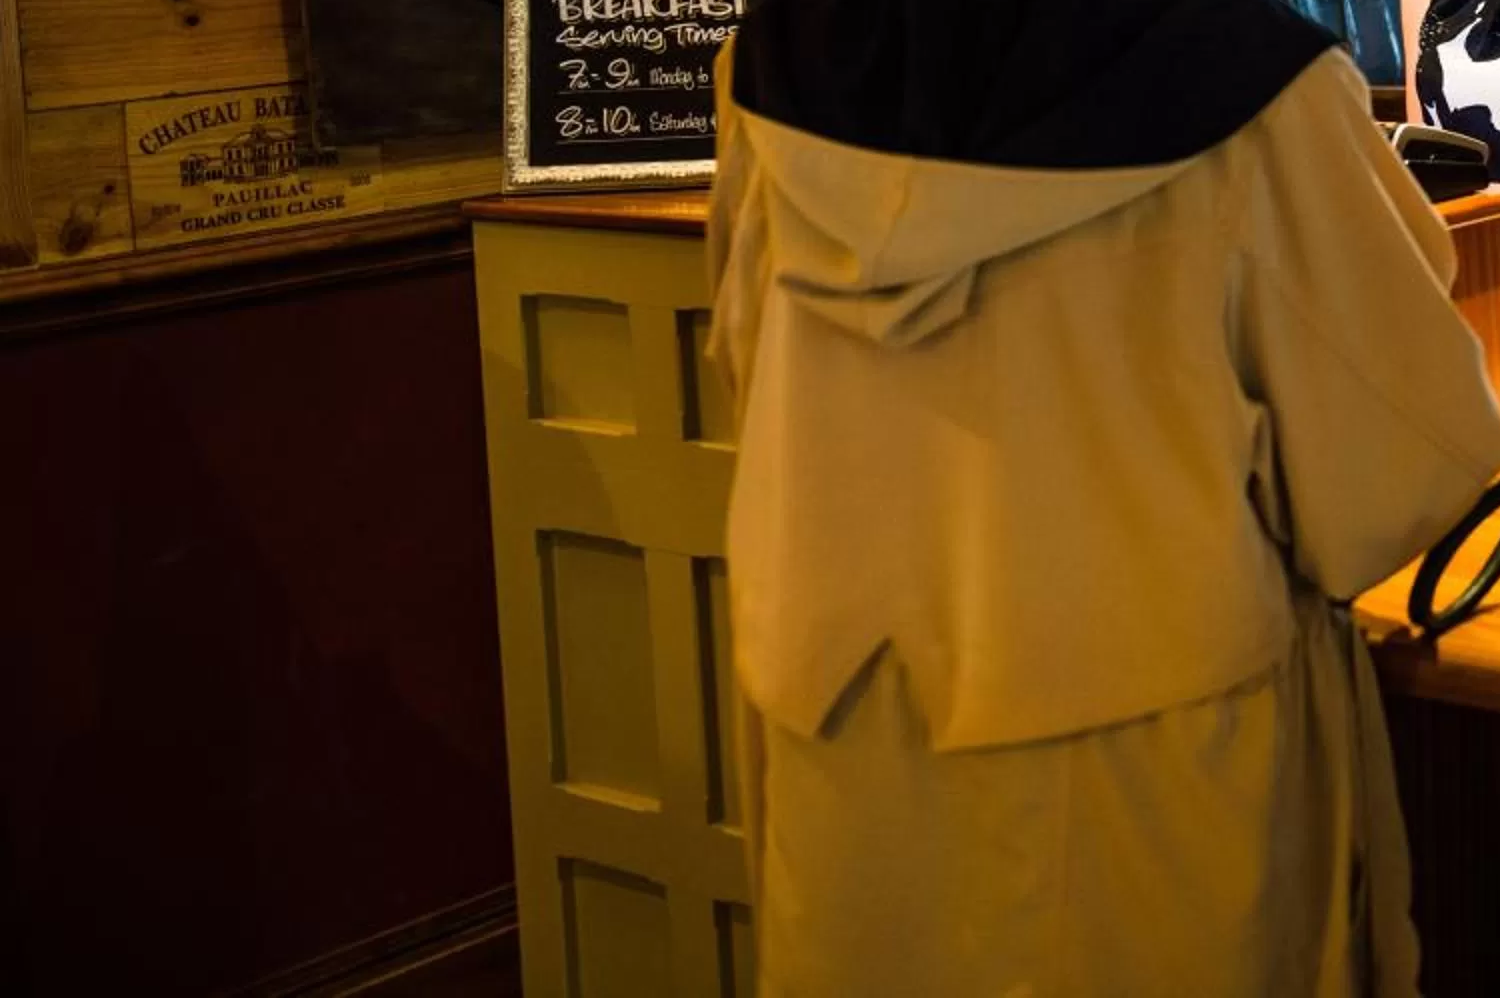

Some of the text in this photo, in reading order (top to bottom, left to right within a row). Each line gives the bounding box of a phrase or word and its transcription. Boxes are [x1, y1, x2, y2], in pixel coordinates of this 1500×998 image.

[556, 25, 667, 54] Serving
[650, 66, 695, 90] Monday
[138, 100, 241, 155] CHATEAU
[649, 110, 708, 133] Saturday
[212, 180, 314, 208] PAUILLAC
[181, 209, 242, 232] GRAND
[247, 203, 283, 221] CRU
